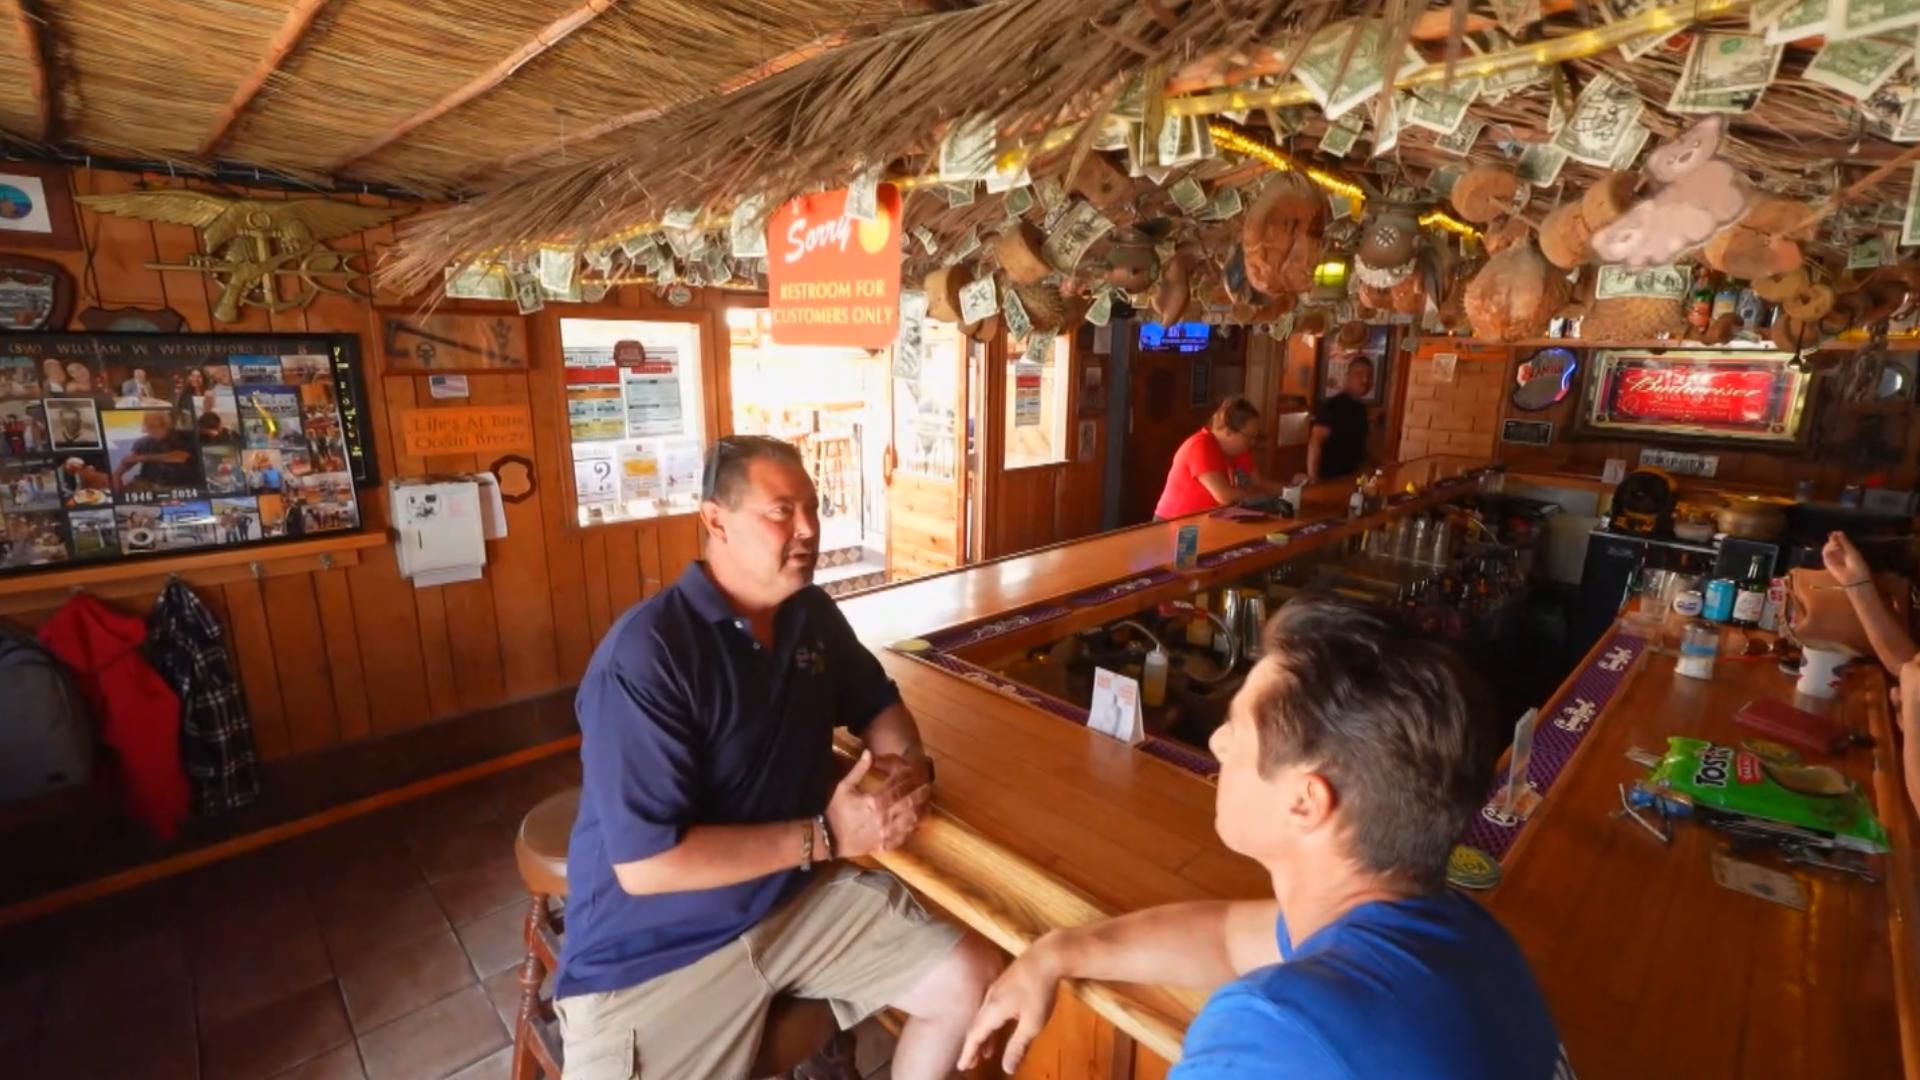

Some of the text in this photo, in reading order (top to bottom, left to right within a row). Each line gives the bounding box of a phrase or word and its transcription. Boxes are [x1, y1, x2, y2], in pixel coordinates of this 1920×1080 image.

[783, 216, 852, 264] Sorry
[780, 279, 885, 300] RESTROOM FOR
[773, 304, 894, 324] CUSTOMERS ONLY
[1627, 374, 1762, 398] Budweiser
